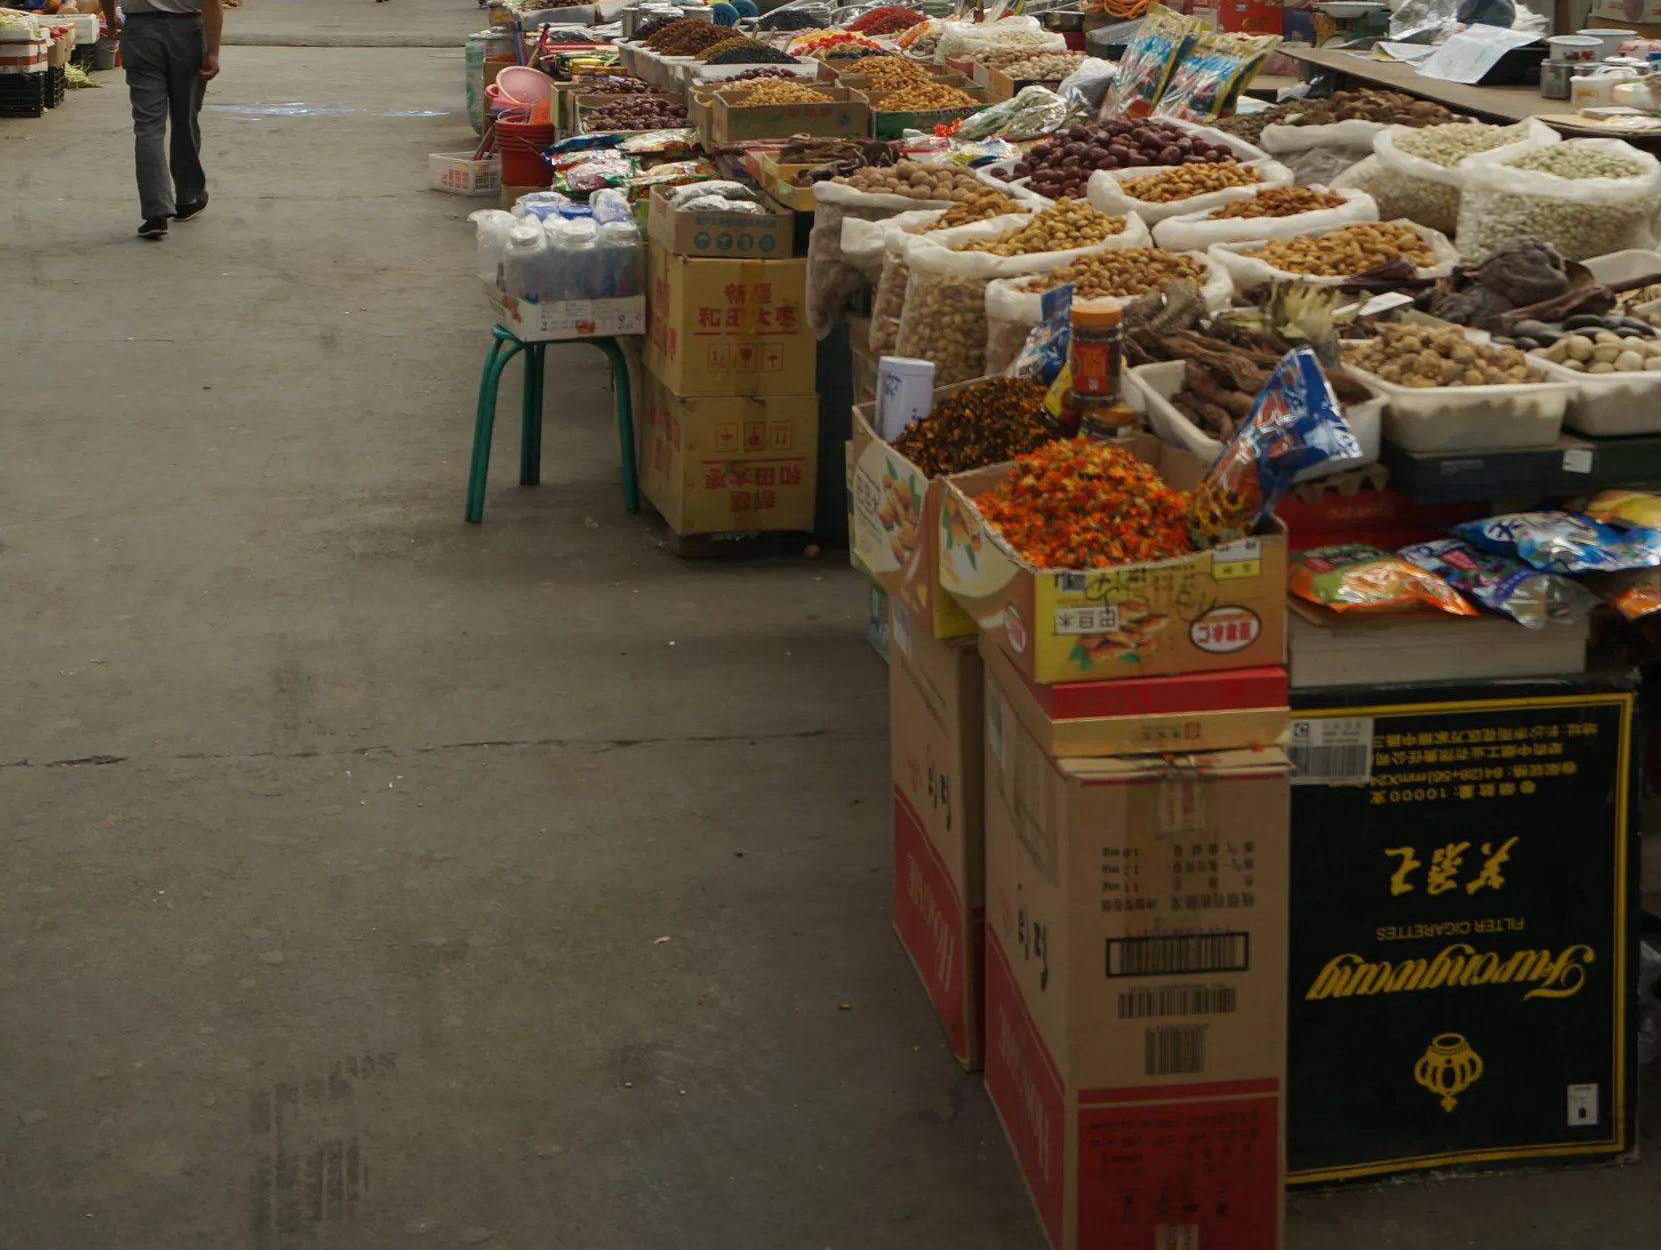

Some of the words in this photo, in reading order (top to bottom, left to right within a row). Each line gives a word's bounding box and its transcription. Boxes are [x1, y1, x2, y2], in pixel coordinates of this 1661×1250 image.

[723, 282, 772, 306] 新疆
[697, 306, 796, 327] 和田大枣
[705, 465, 802, 489] 和田大枣
[1058, 610, 1116, 630] 巴旦木
[1384, 836, 1520, 896] 芙蓉王
[1376, 921, 1471, 941] CIGARETTES
[1474, 916, 1525, 933] FILTER
[1304, 943, 1595, 1001] Furongwang
